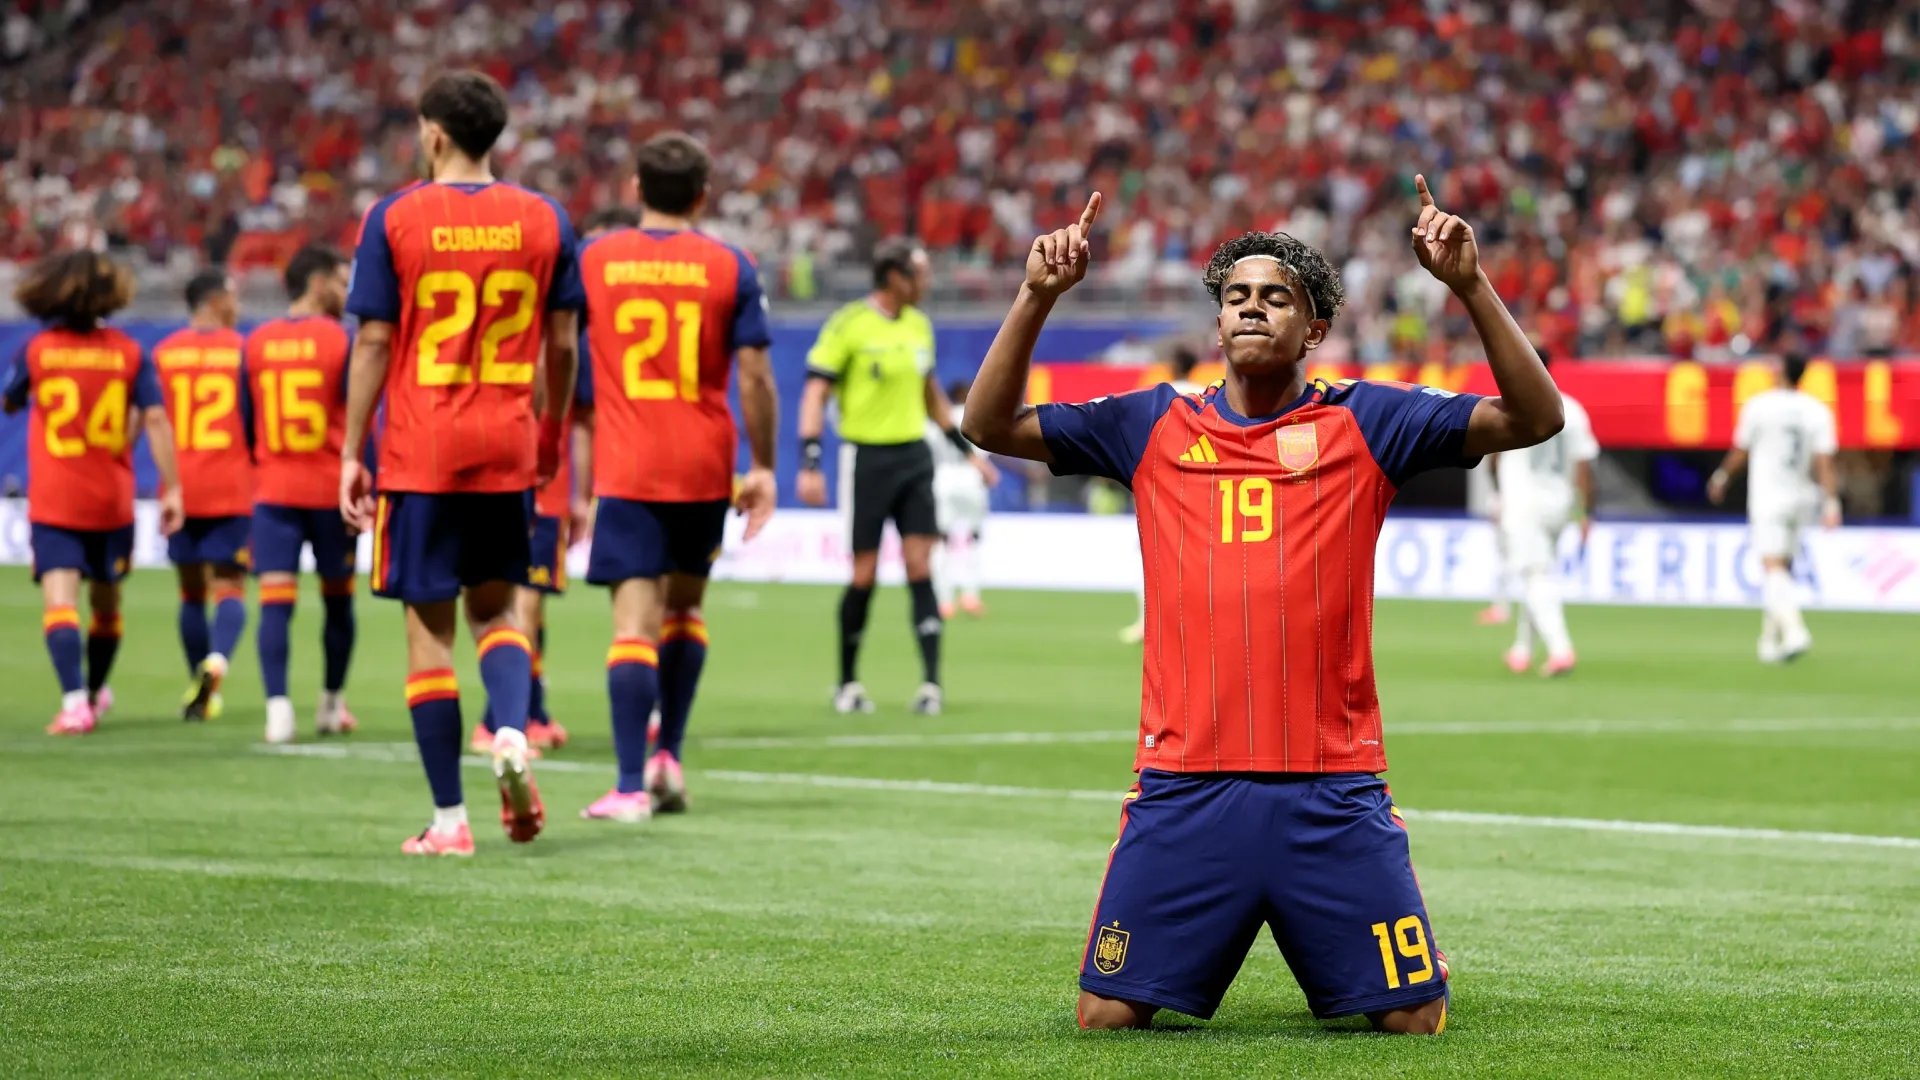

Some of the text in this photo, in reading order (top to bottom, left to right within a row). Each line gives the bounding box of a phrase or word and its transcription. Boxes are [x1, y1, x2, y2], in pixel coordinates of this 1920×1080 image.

[432, 221, 521, 251] CUBARSÍ
[417, 270, 537, 386] 22
[614, 299, 701, 403] 21
[38, 376, 127, 457] 24
[171, 373, 236, 451] 12
[259, 369, 327, 452] 15
[1219, 477, 1273, 543] 19
[1388, 527, 1822, 594] OF MERICA
[1371, 914, 1434, 989] 19
